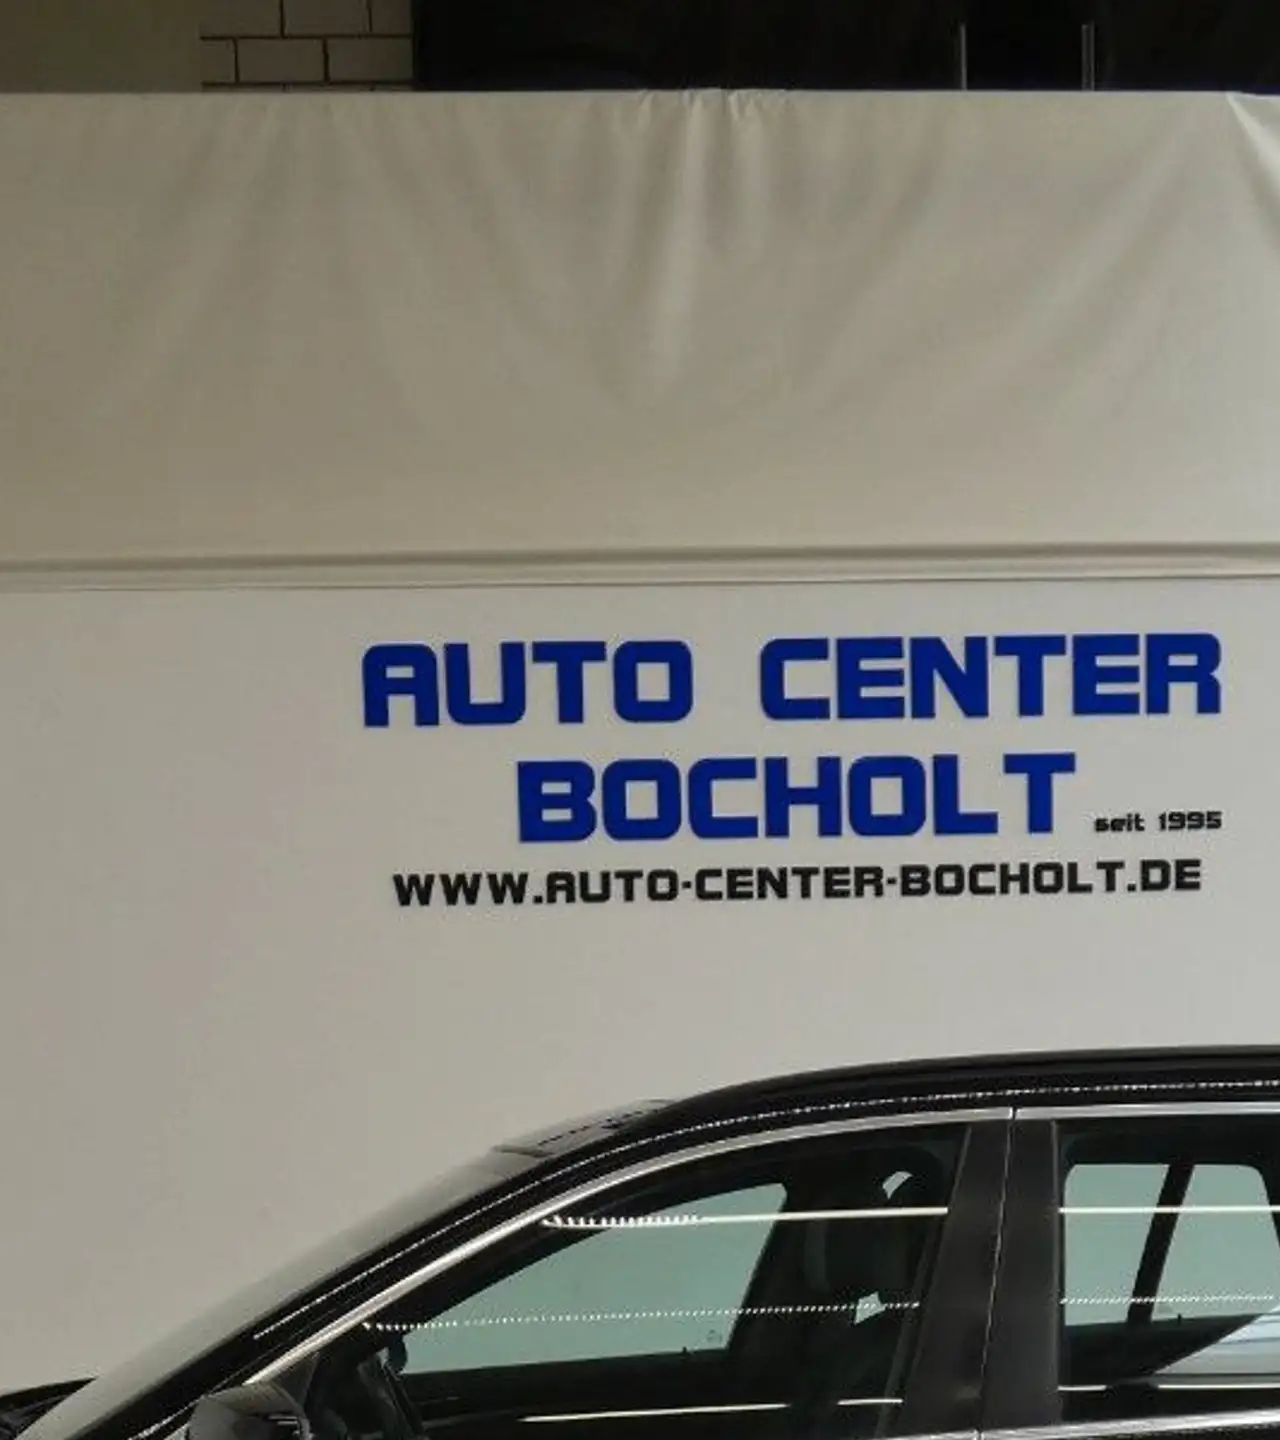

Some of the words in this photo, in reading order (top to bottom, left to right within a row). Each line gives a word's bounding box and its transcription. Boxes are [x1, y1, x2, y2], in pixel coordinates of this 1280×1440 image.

[361, 640, 694, 729] AUTO
[759, 633, 1222, 721] CENTER
[516, 752, 1076, 844] BOCHOLT
[1093, 812, 1146, 834] seit
[1158, 810, 1223, 832] 1995
[392, 858, 1201, 907] WWW.AUTO-CENTER-BOCHOLT.DE
